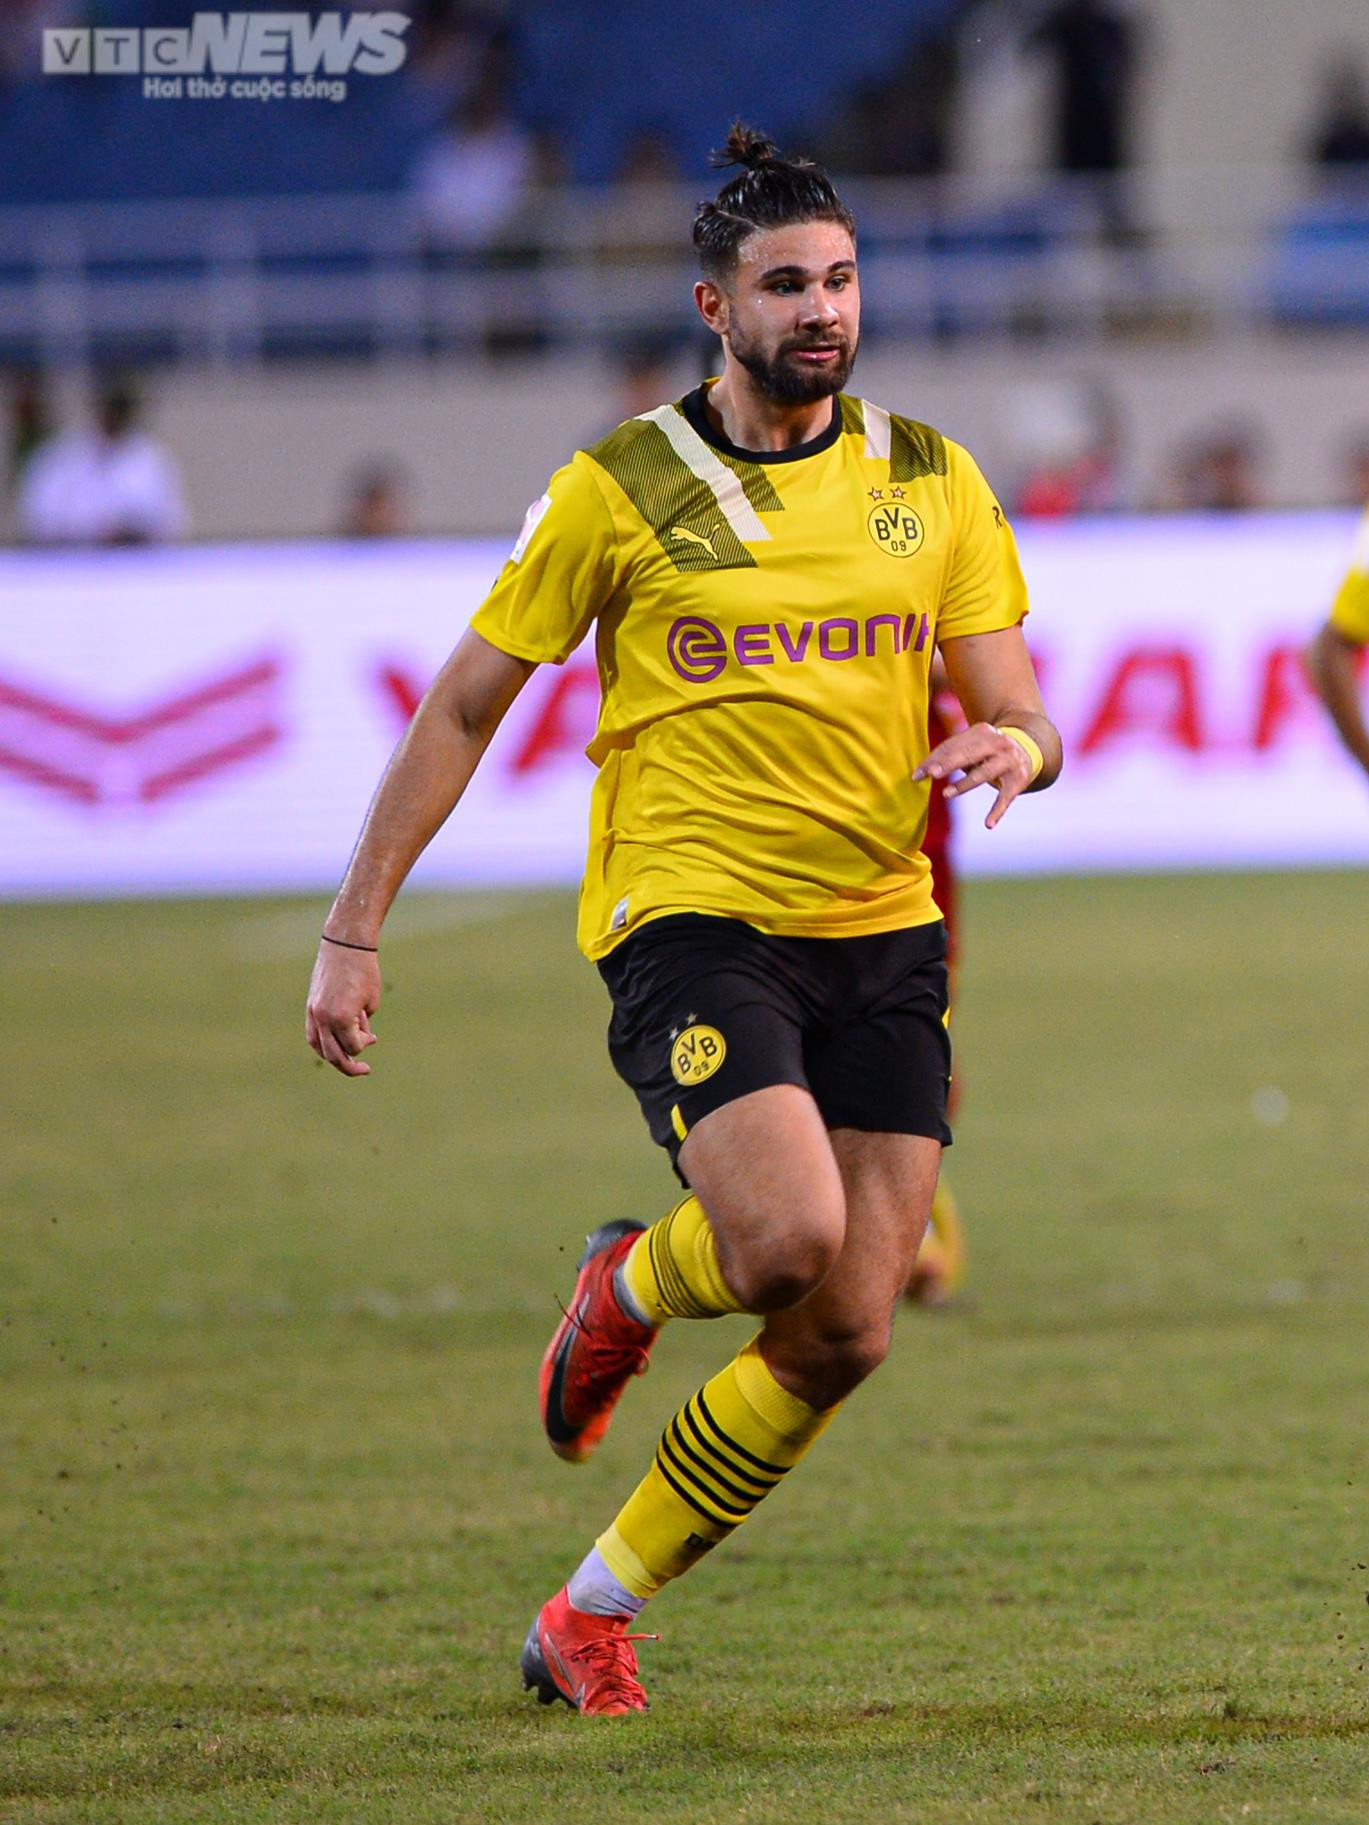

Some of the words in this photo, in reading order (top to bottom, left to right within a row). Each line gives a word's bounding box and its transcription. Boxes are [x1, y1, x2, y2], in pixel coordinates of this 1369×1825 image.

[874, 507, 918, 540] BVB
[891, 540, 907, 552] 09
[677, 1032, 717, 1075] BVB
